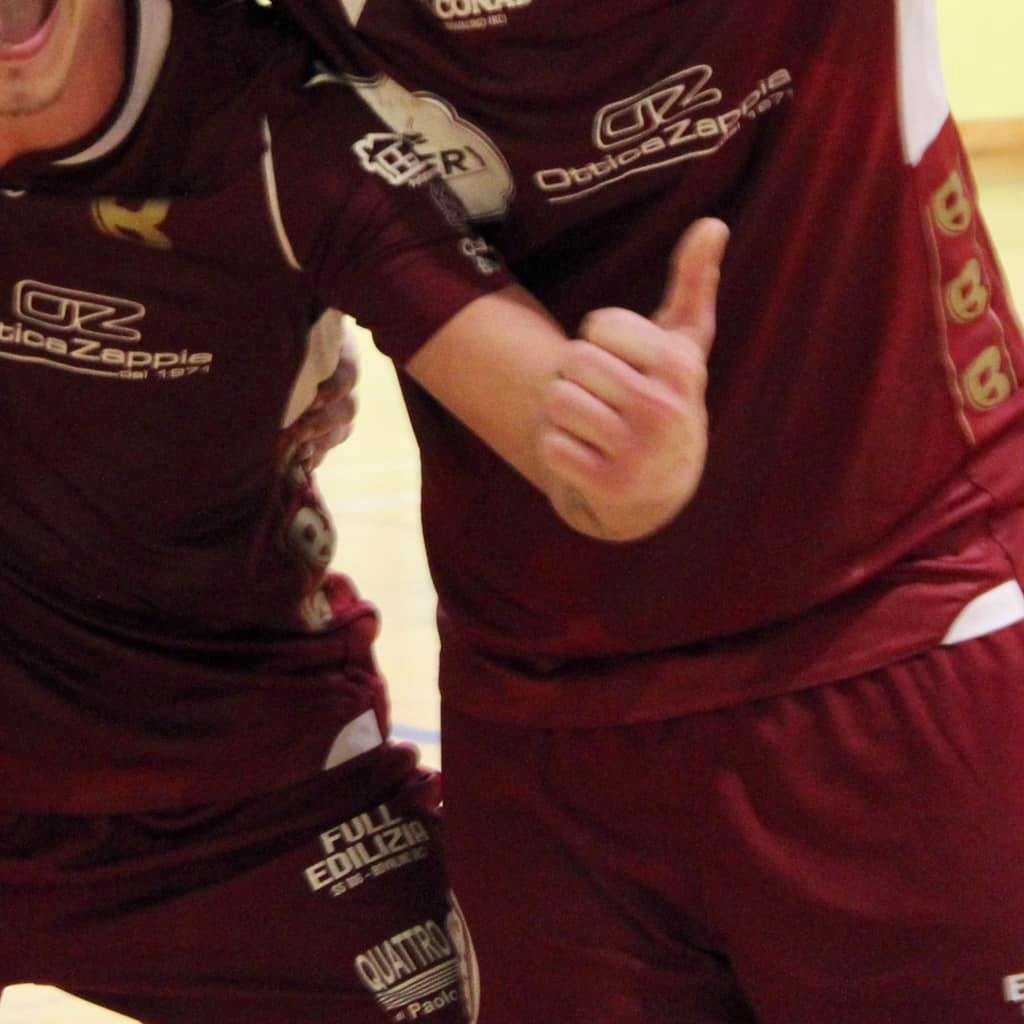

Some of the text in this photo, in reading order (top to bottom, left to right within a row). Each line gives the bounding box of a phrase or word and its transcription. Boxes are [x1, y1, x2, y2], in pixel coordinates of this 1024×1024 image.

[303, 820, 430, 892] EDILIZIA
[320, 803, 404, 854] FULL
[354, 920, 452, 993] QUATTRO
